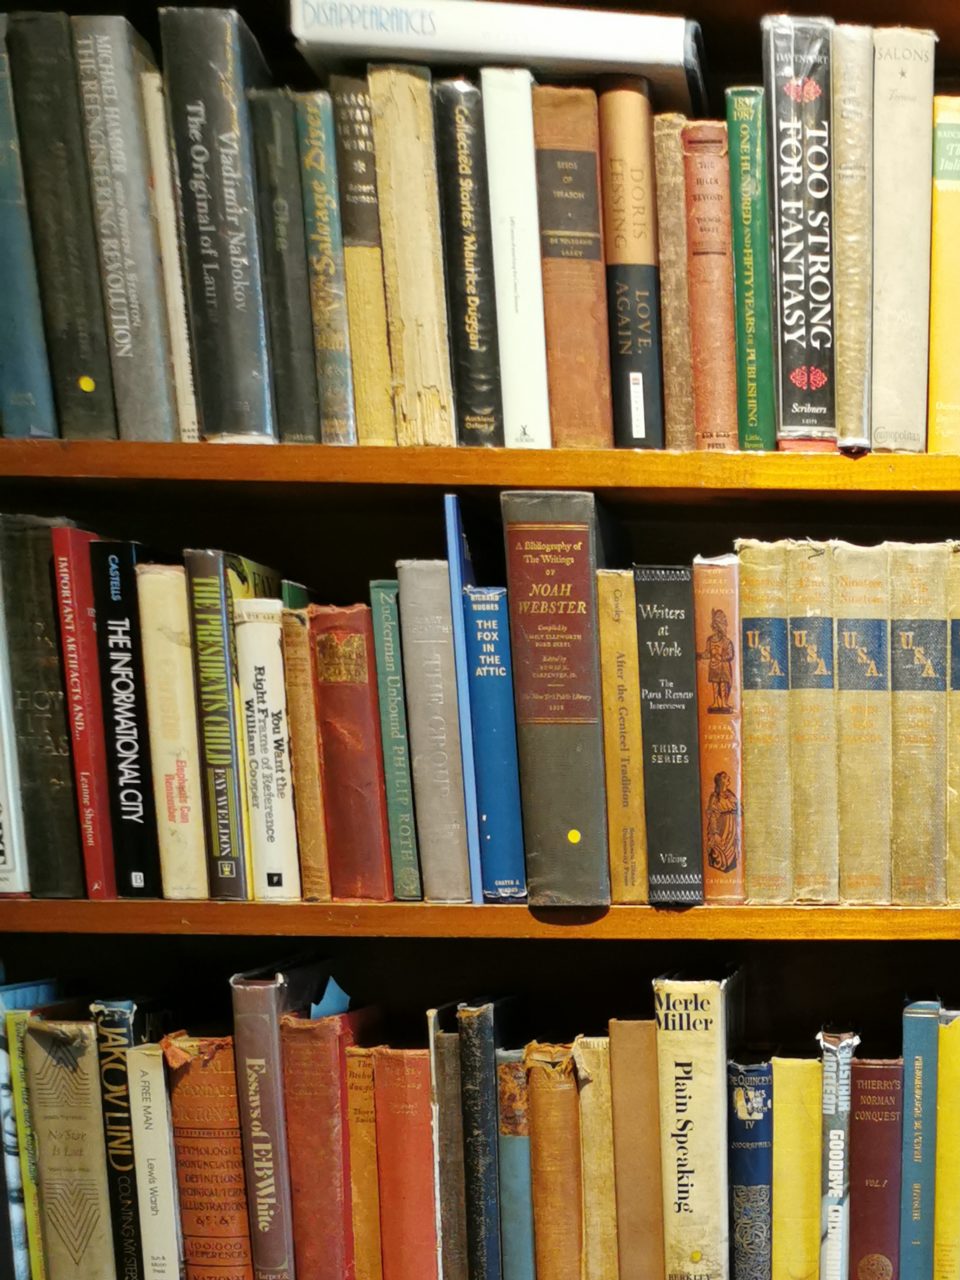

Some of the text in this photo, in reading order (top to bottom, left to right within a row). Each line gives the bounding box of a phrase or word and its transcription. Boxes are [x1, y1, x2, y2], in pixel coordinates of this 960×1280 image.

[303, 2, 437, 37] DISAPPEARANCES
[877, 47, 930, 62] SALONS
[455, 106, 474, 175] Collected
[76, 36, 97, 80] THE
[102, 238, 133, 359] REVOLUTION
[459, 178, 475, 228] Stories
[609, 158, 627, 250] LESSING
[629, 168, 648, 240] DORIS
[217, 131, 250, 312] Vladimir Nabokov
[779, 119, 807, 350] FOR FANTASY
[805, 120, 832, 351] TOO STRONG
[462, 296, 482, 351] Duggan
[614, 282, 633, 357] AGAIN
[108, 555, 123, 601] CASTELLS
[529, 584, 573, 597] NOAH
[518, 602, 588, 614] WEBSTER
[638, 604, 687, 622] Writers
[477, 620, 498, 629] THE
[657, 626, 670, 637] at
[477, 632, 499, 641] FOX
[483, 644, 495, 652] IN
[646, 641, 682, 658] Work
[479, 655, 501, 664] THE
[476, 667, 507, 676] ATTIC
[107, 618, 144, 824] THE INFORMATIONAL CITY
[243, 698, 262, 810] William Cooper
[270, 710, 288, 799] You Want the
[651, 754, 690, 764] SERIES
[652, 744, 688, 754] THIRD
[659, 852, 688, 867] Viking
[655, 992, 711, 1012] Merle
[655, 1012, 714, 1032] Miller
[141, 1081, 152, 1103] FREE
[856, 1079, 902, 1090] THIERRY'S
[860, 1095, 896, 1106] NORMAN
[143, 1105, 155, 1131] MAN
[855, 1110, 901, 1122] CONQUEST
[670, 1060, 696, 1215] Plain Speaking
[146, 1158, 161, 1217] Lewis Warsh
